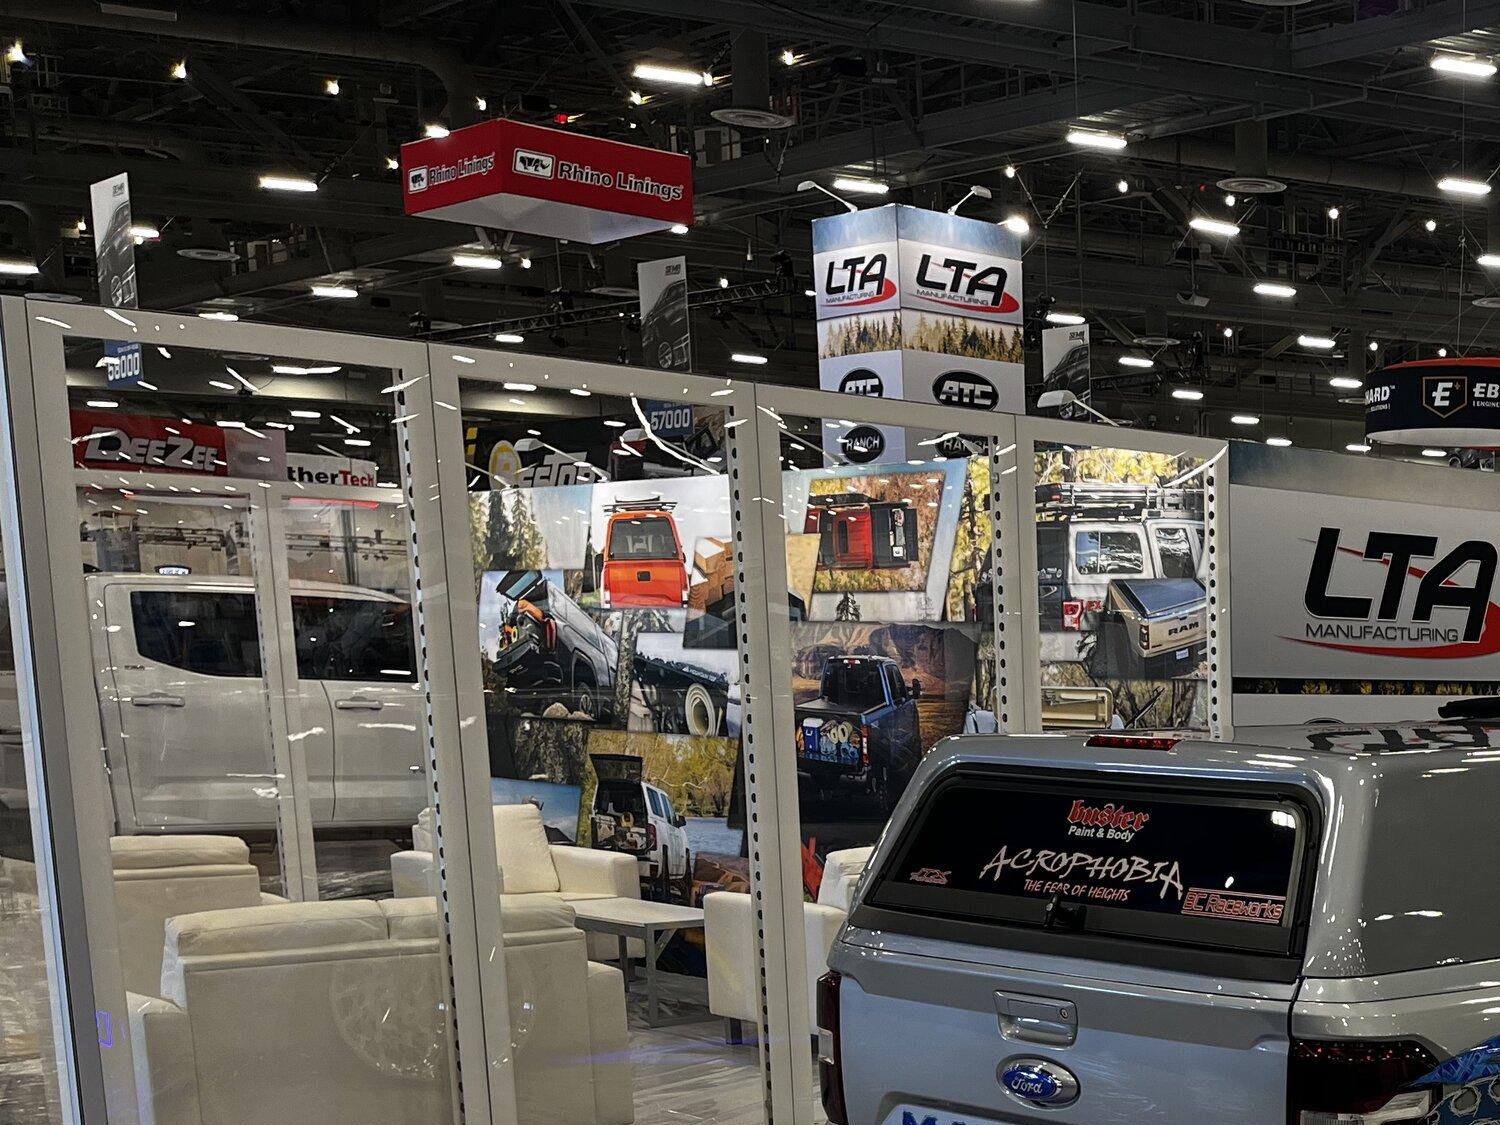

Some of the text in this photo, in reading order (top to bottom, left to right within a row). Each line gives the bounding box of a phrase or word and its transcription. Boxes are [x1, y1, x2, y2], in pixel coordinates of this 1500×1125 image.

[428, 152, 495, 187] Rhino Linings
[559, 161, 683, 201] Rhino Linings
[825, 253, 887, 295] LTA
[916, 253, 1008, 307] LTA
[826, 291, 875, 304] MANUFACTURING
[916, 289, 989, 306] MANUFACTURING
[939, 381, 993, 405] ATC
[651, 409, 691, 430] 57000
[846, 436, 880, 450] RANCH
[1304, 526, 1498, 643] LTA
[1168, 621, 1200, 637] RAM
[1305, 622, 1459, 642] MANUFACTURING
[1067, 800, 1149, 832] buster
[1068, 825, 1135, 842] Paint & Body
[979, 845, 1183, 900] ACROPHOBIA
[1024, 879, 1131, 901] THE FEAR OF HEIGHTS
[1182, 892, 1284, 919] BC Raceworks
[1011, 1076, 1044, 1095] Ford
